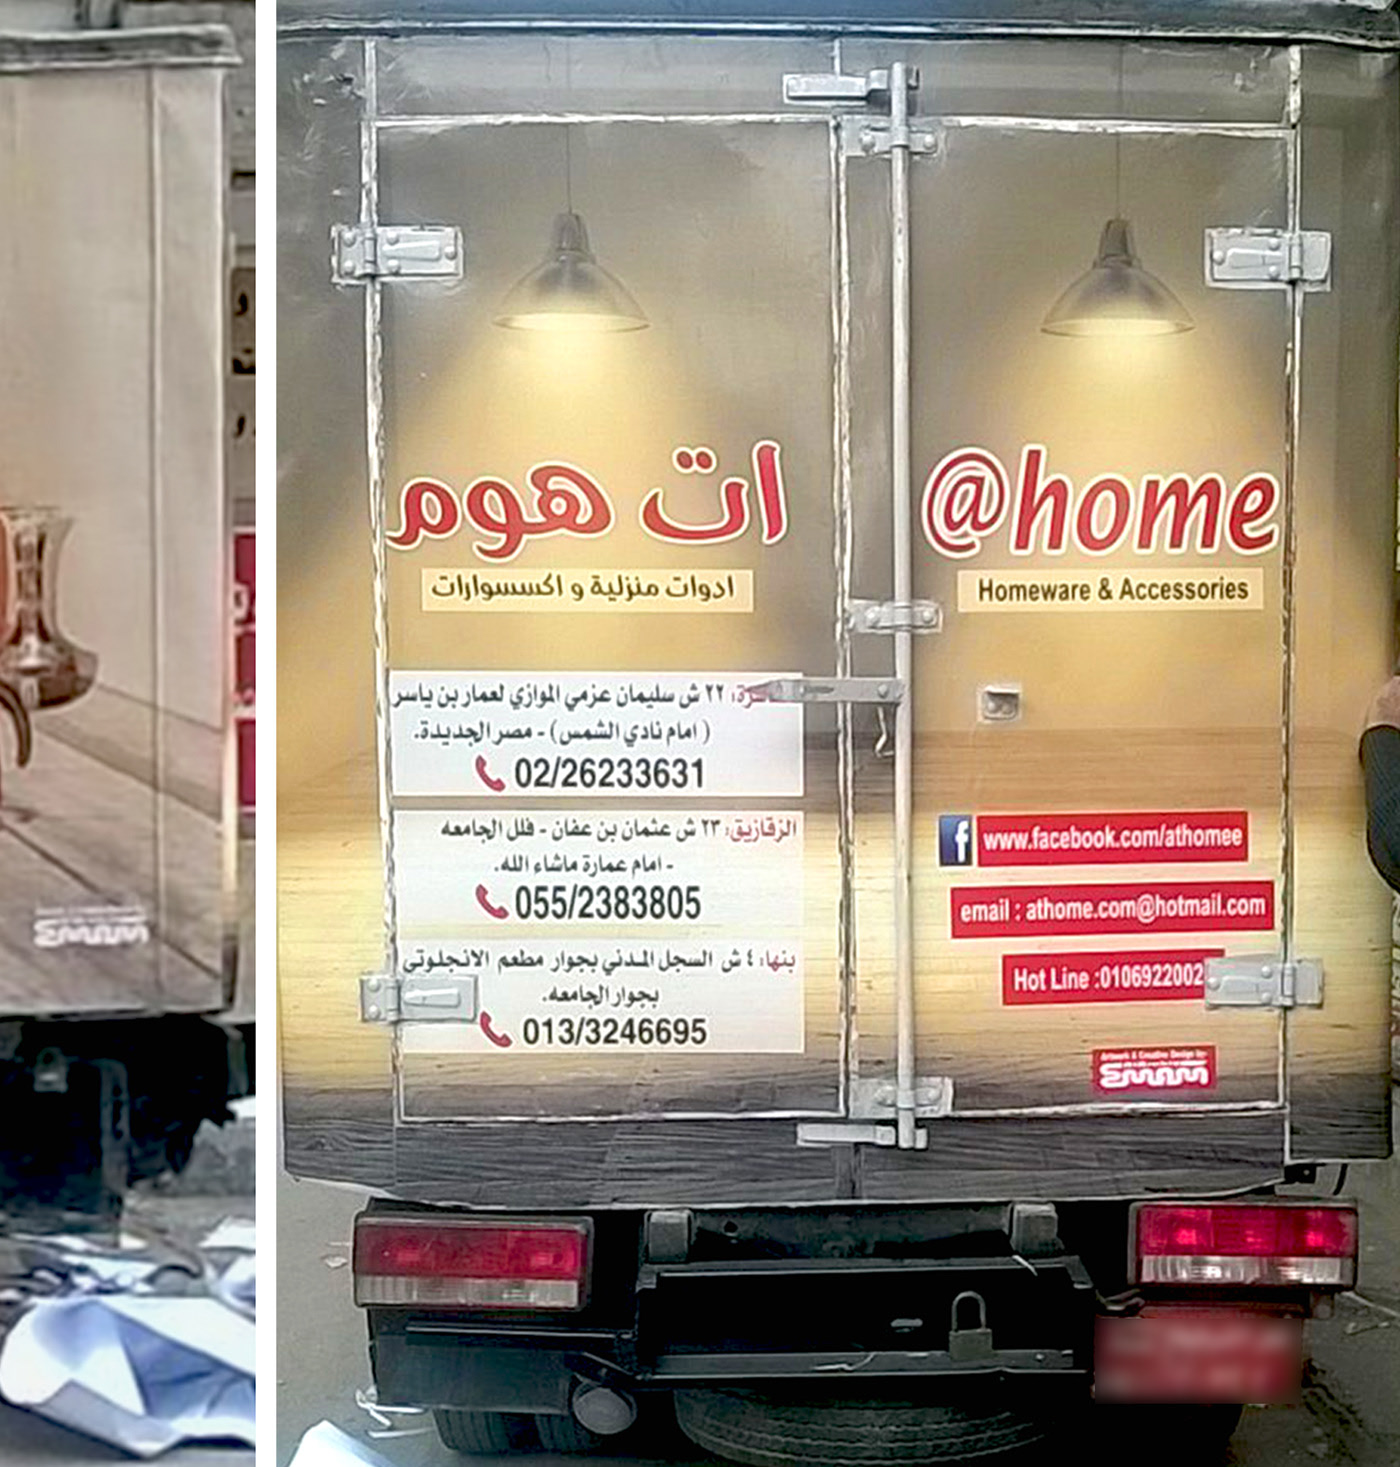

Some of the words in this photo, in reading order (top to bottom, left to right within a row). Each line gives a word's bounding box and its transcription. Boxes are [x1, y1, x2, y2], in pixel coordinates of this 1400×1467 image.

[639, 439, 788, 546] ات
[923, 444, 1281, 559] @home
[386, 460, 616, 563] هوم
[431, 572, 564, 602] اكسسوارات
[570, 582, 585, 602] و
[590, 574, 660, 603] منزلية
[665, 574, 734, 603] ادوات
[978, 578, 1092, 602] Homeware
[1098, 577, 1114, 601] &
[1118, 575, 1249, 601] Accessories
[392, 683, 434, 709] ياسر
[437, 686, 459, 709] بن
[461, 683, 505, 708] لعمار
[509, 683, 561, 711] الموازي
[564, 683, 612, 712] عزمي
[616, 684, 675, 709] سليمان
[678, 683, 700, 710] ش
[705, 684, 724, 702] ٢٢
[492, 727, 533, 746] مصر
[623, 720, 663, 748] نادي
[666, 722, 697, 746] امام
[514, 756, 703, 789] 02/26233631
[440, 818, 503, 844] الجامعه
[506, 817, 535, 842] فلل
[551, 818, 593, 842] عفان
[596, 821, 618, 843] بن
[621, 817, 672, 842] عثمان
[675, 817, 697, 843] ش
[701, 818, 721, 835] ٢٣
[725, 816, 797, 844] الزقازيق:
[983, 823, 1243, 851] www.facebook.com/athomee
[533, 853, 578, 874] ماشاء
[582, 854, 628, 878] عمارة
[631, 854, 662, 877] امام
[515, 883, 702, 920] 055/2383805
[960, 899, 1009, 923] email
[1026, 892, 1266, 923] athome.com@hotmail.com
[497, 949, 544, 973] مطعم
[550, 951, 599, 974] بجوار
[601, 949, 655, 977] المدني
[658, 949, 713, 973] السجل
[721, 948, 742, 974] ش
[759, 949, 796, 974] بنها:
[1013, 965, 1047, 992] Hot
[1049, 965, 1091, 990] Line
[611, 987, 660, 1009] بجوار
[523, 1016, 708, 1046] 013/3246695
